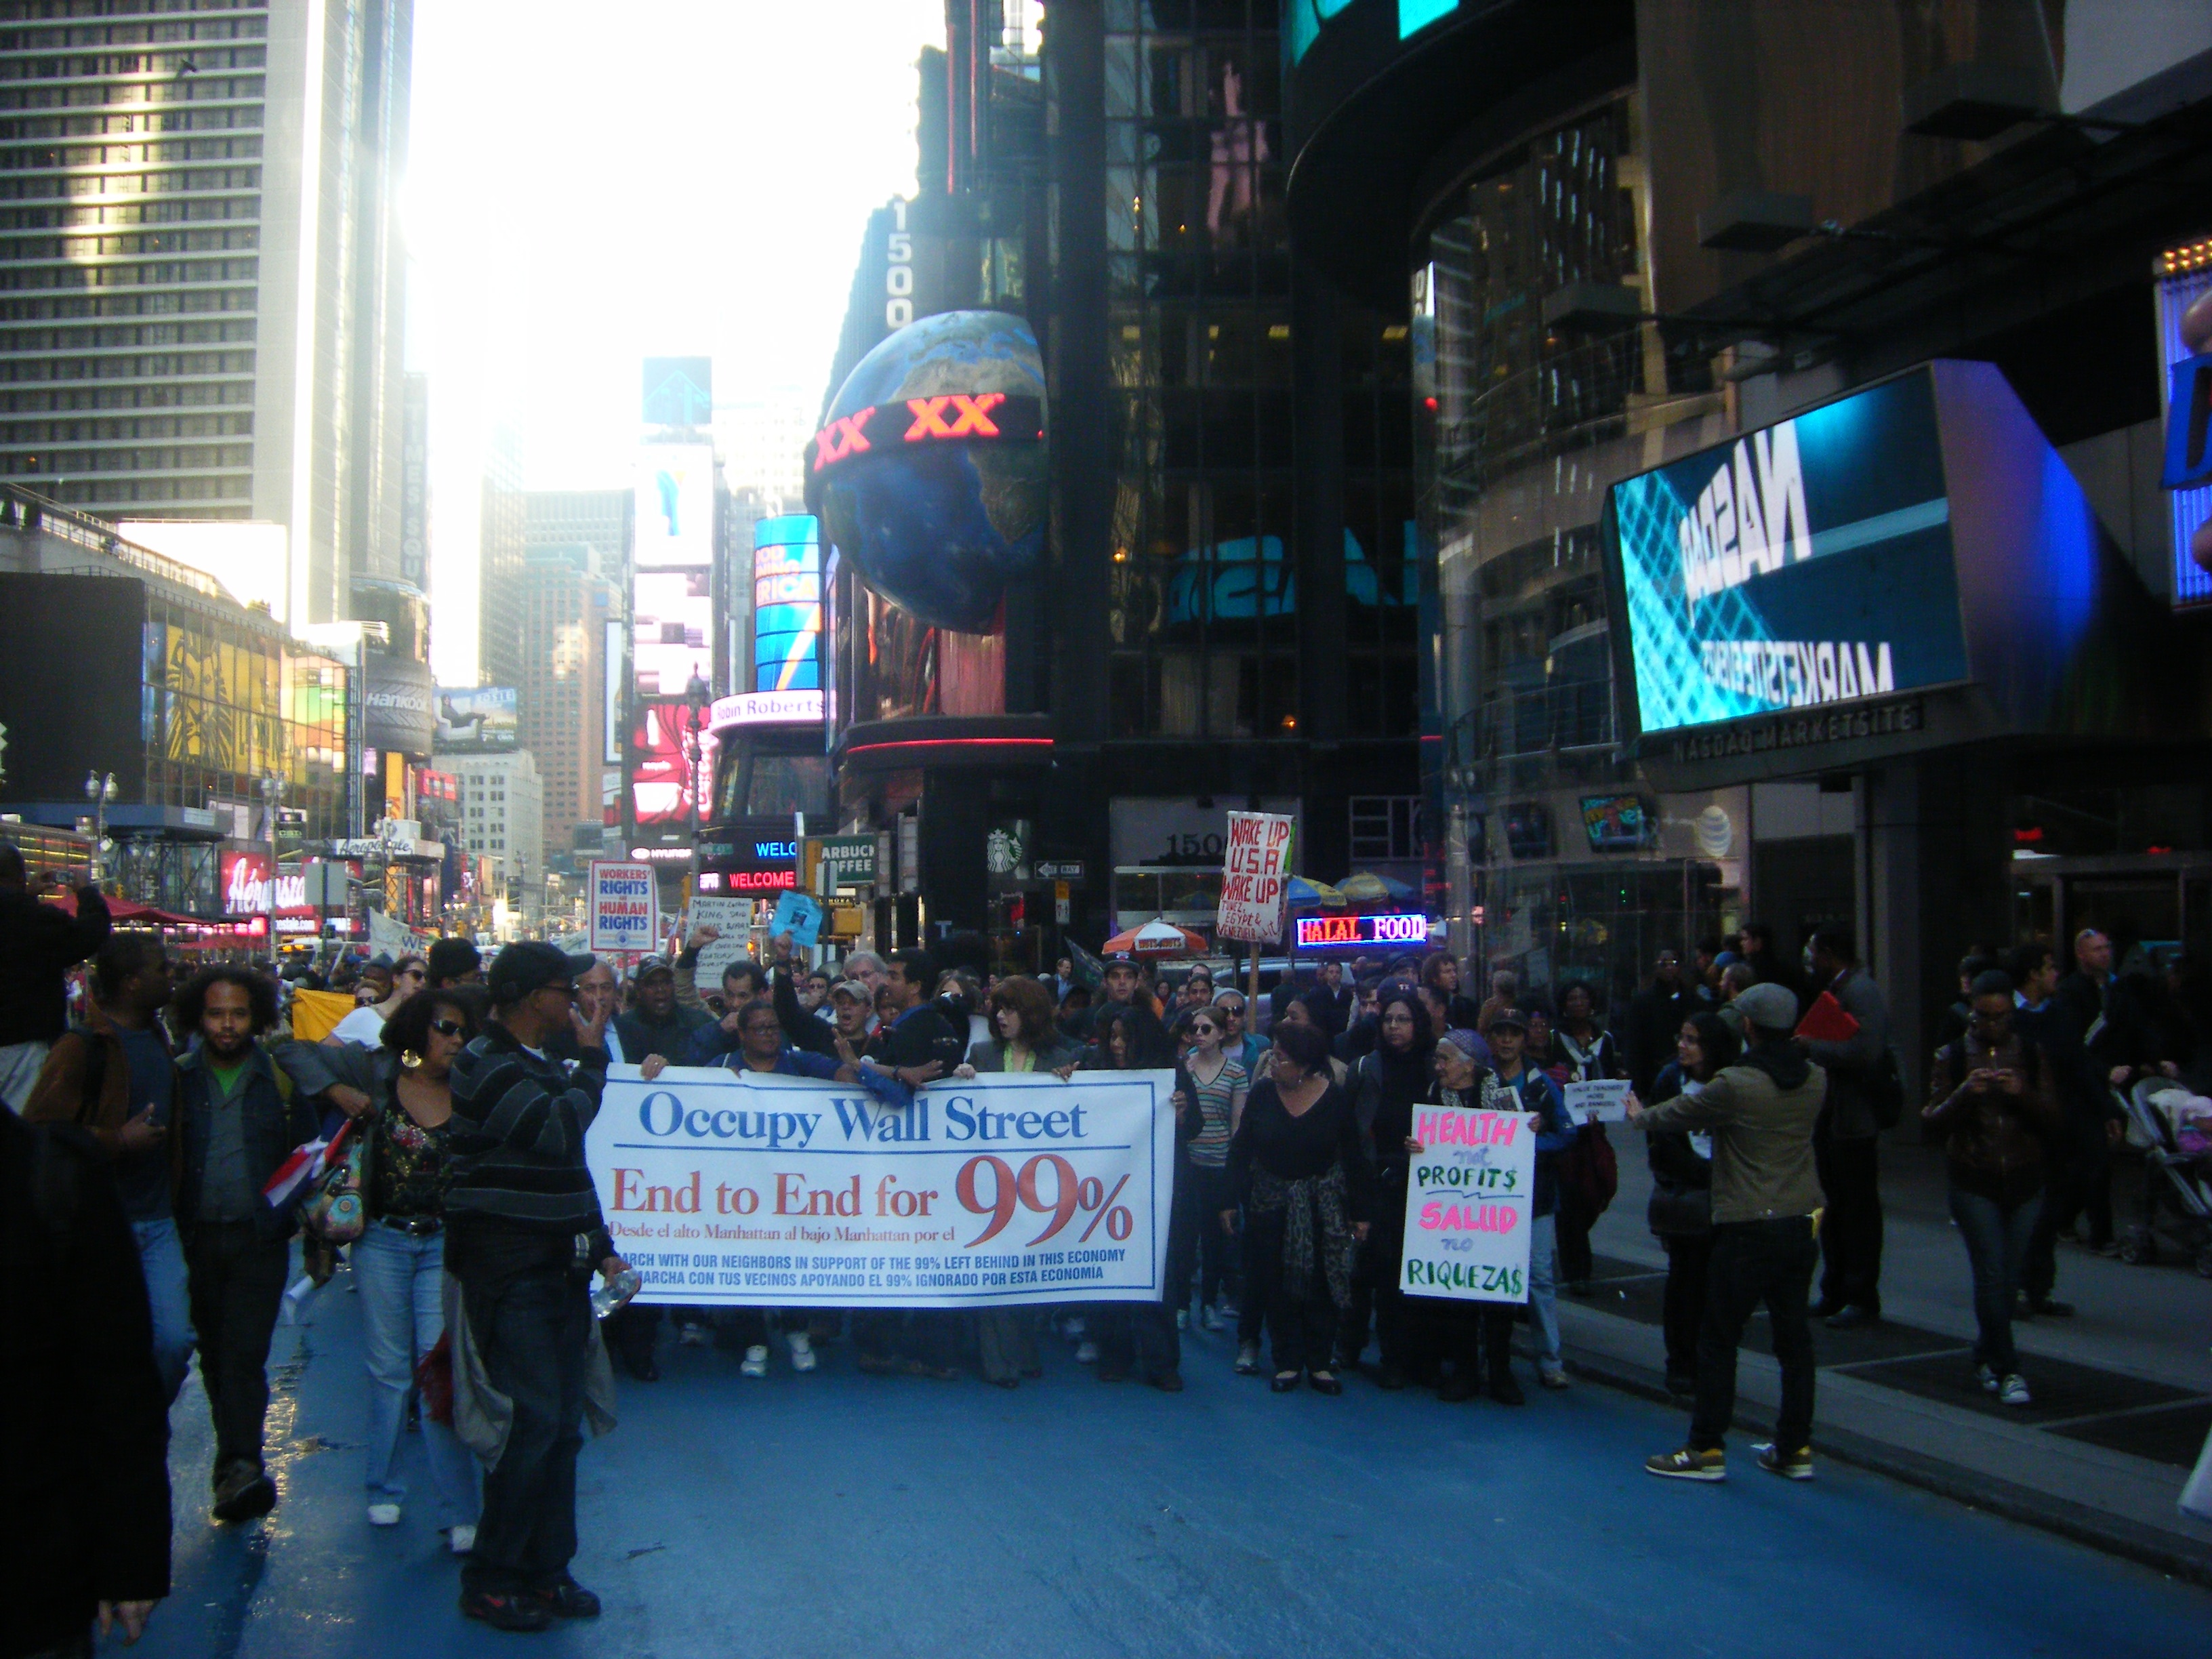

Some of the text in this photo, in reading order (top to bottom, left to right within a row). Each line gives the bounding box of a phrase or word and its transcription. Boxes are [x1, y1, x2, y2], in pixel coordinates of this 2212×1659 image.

[886, 201, 913, 328] 1500
[747, 699, 824, 715] Roberts
[1231, 817, 1289, 848] WAKE UP
[600, 880, 649, 895] RIGHTS
[729, 871, 795, 889] WELCOME
[1221, 875, 1278, 904] WAKE UP
[599, 902, 648, 915] HUMAN
[697, 909, 724, 920] KING
[599, 916, 648, 930] RIGHTS
[1373, 916, 1425, 941] FOOD
[639, 1090, 1088, 1149] Occupy Wall Street
[1415, 1110, 1519, 1147] HEALTH
[610, 1153, 1134, 1249] End to End for 99%
[1418, 1201, 1518, 1235] SALUD
[610, 1221, 955, 1244] Desde el alto Manhattan al bajo Manhattan por el
[619, 1248, 1126, 1270] ARCH WITH OUR NEIGHBORS IN SUPPORT OF THE 99% LEFT BEHIND IN THIS ECONOMY
[689, 1271, 714, 1286] CON
[718, 1272, 741, 1286] TUS
[745, 1273, 797, 1287] VECINOS
[800, 1273, 865, 1287] APOYANDO
[869, 1273, 882, 1287] EL
[886, 1273, 912, 1288] 99%
[916, 1272, 979, 1287] IGNORADO
[983, 1272, 1007, 1286] POR
[1010, 1269, 1038, 1284] ESTA
[1042, 1263, 1104, 1282] ECONOMÍA
